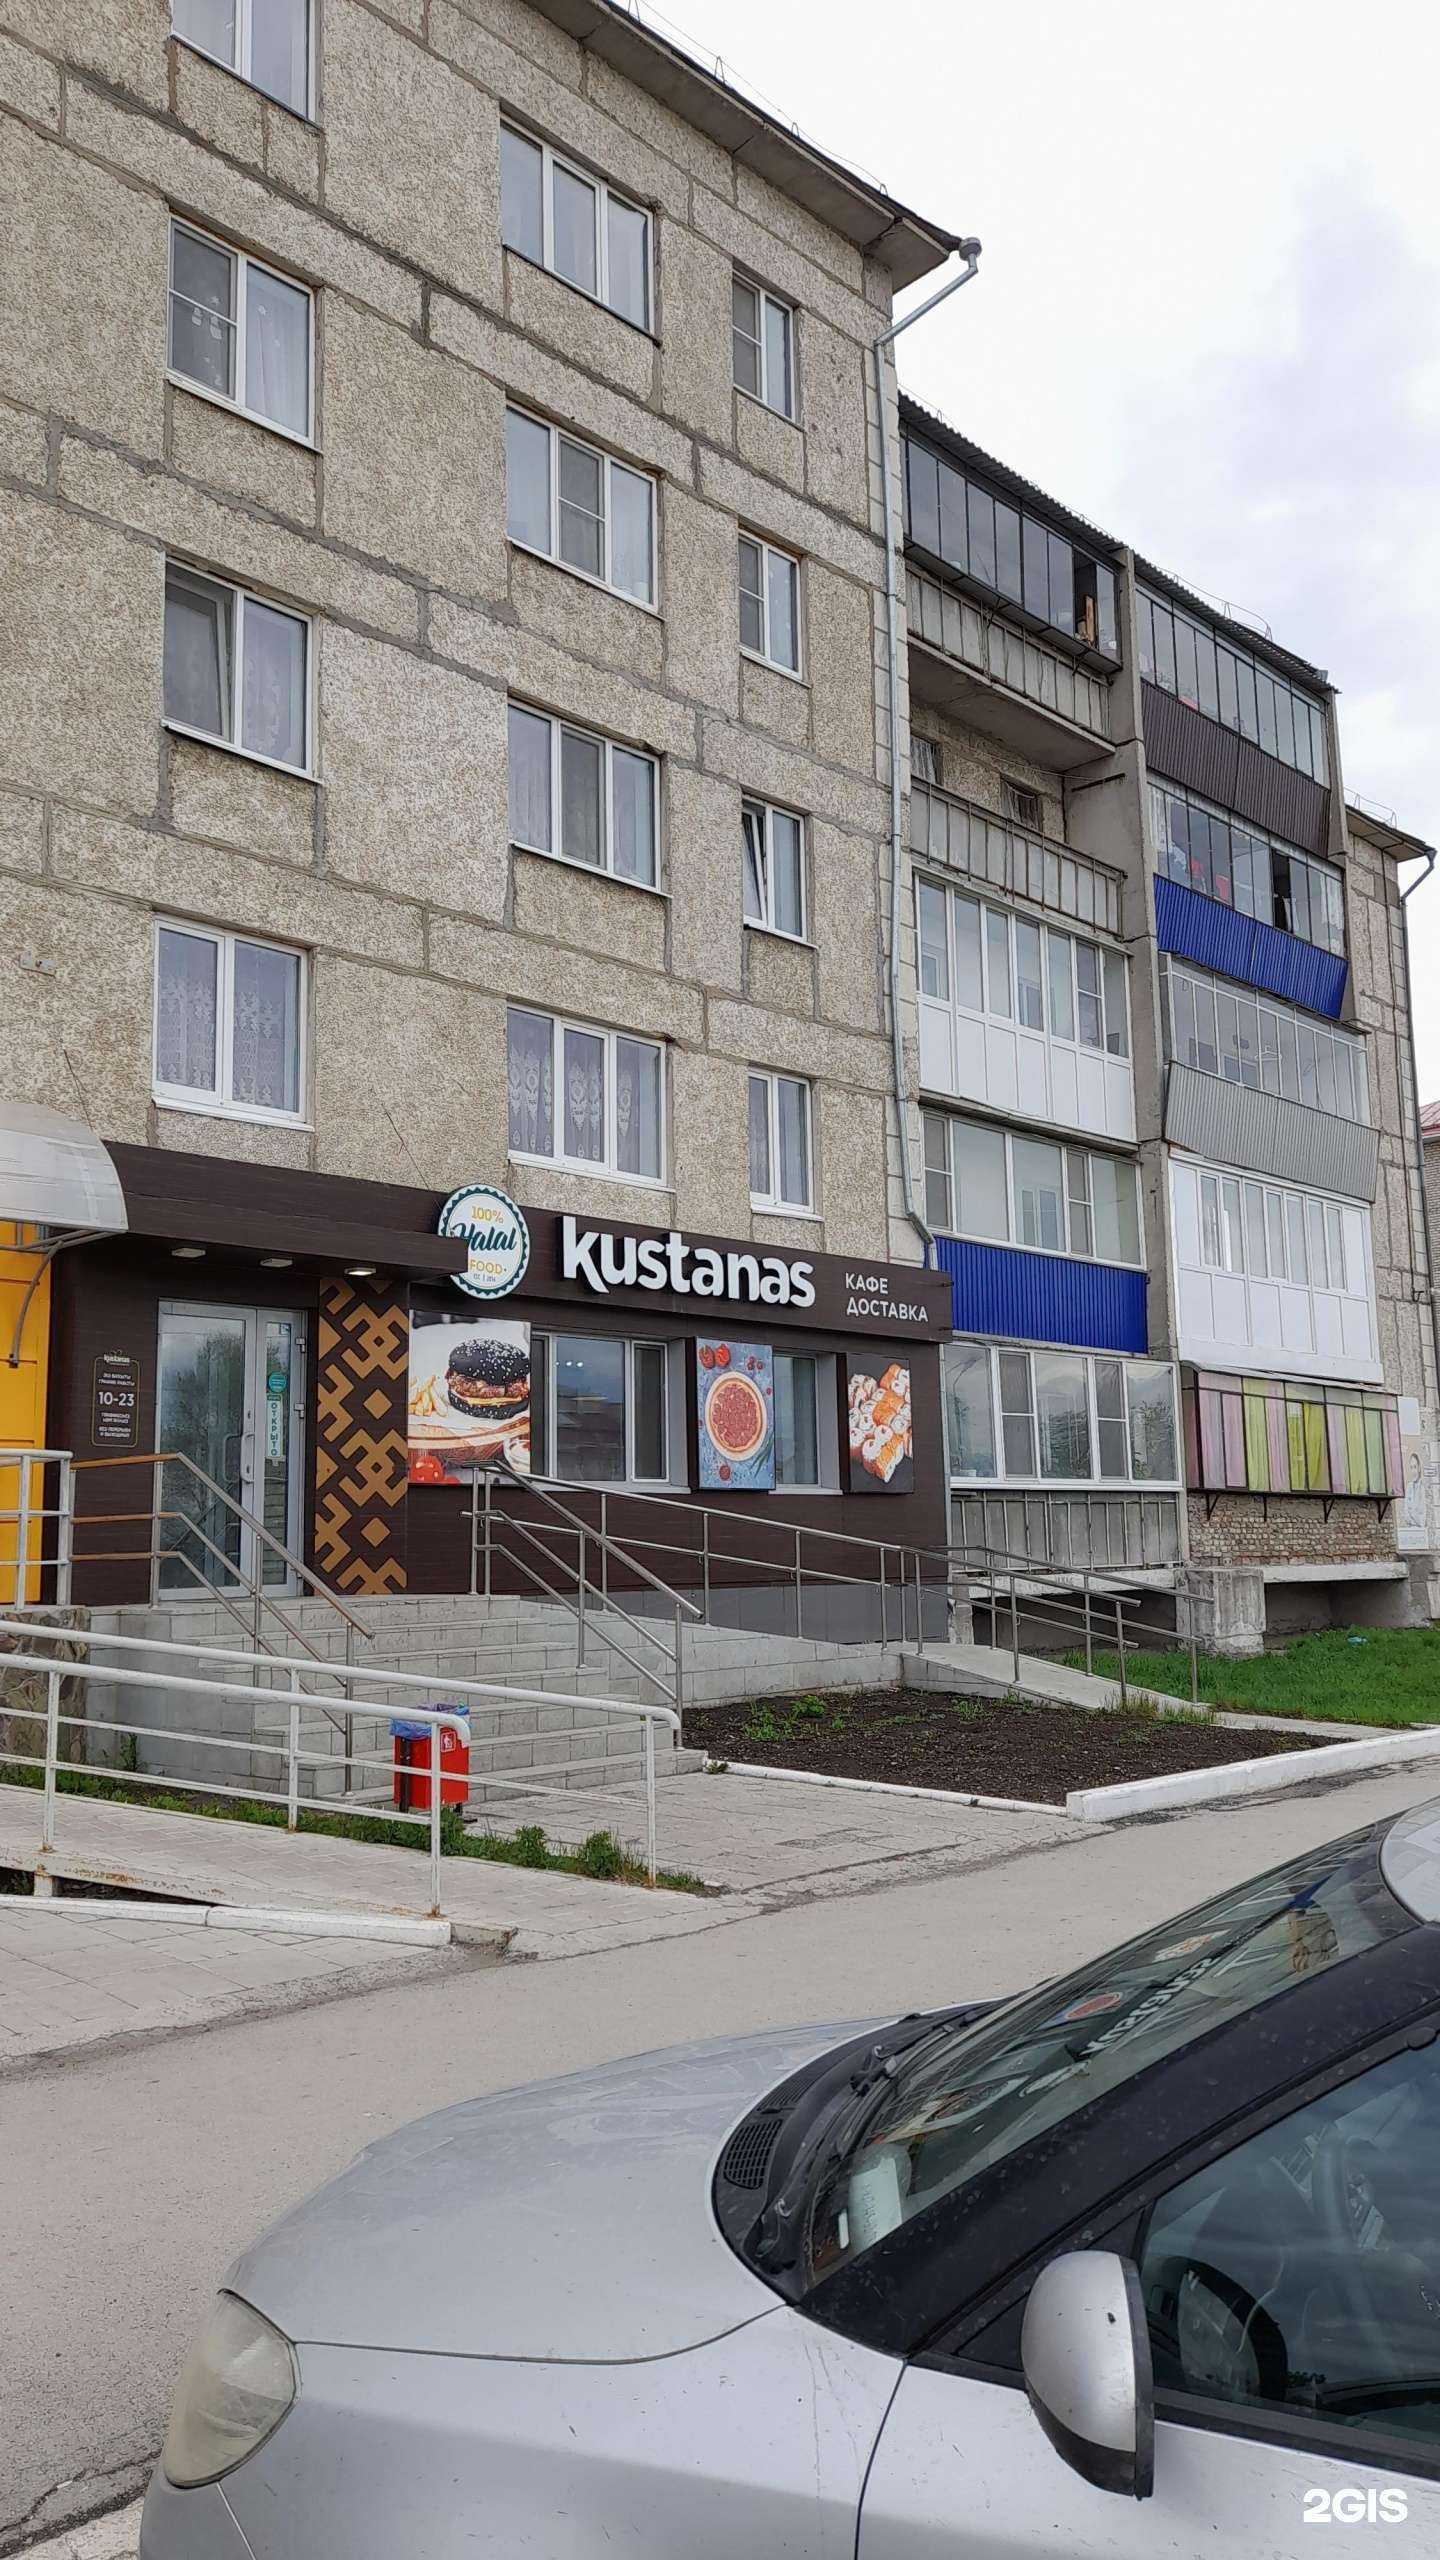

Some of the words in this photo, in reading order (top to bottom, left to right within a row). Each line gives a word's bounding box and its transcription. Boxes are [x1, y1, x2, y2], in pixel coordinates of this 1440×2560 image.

[472, 1206, 504, 1224] 100%
[450, 1222, 517, 1251] Halal
[470, 1259, 503, 1275] FOOD
[562, 1215, 816, 1308] kustanas
[845, 1272, 888, 1295] КАФЕ
[846, 1298, 929, 1323] ДОСТАВКА
[98, 1391, 135, 1407] 10-23
[270, 1402, 279, 1456] ОТКРЫТО
